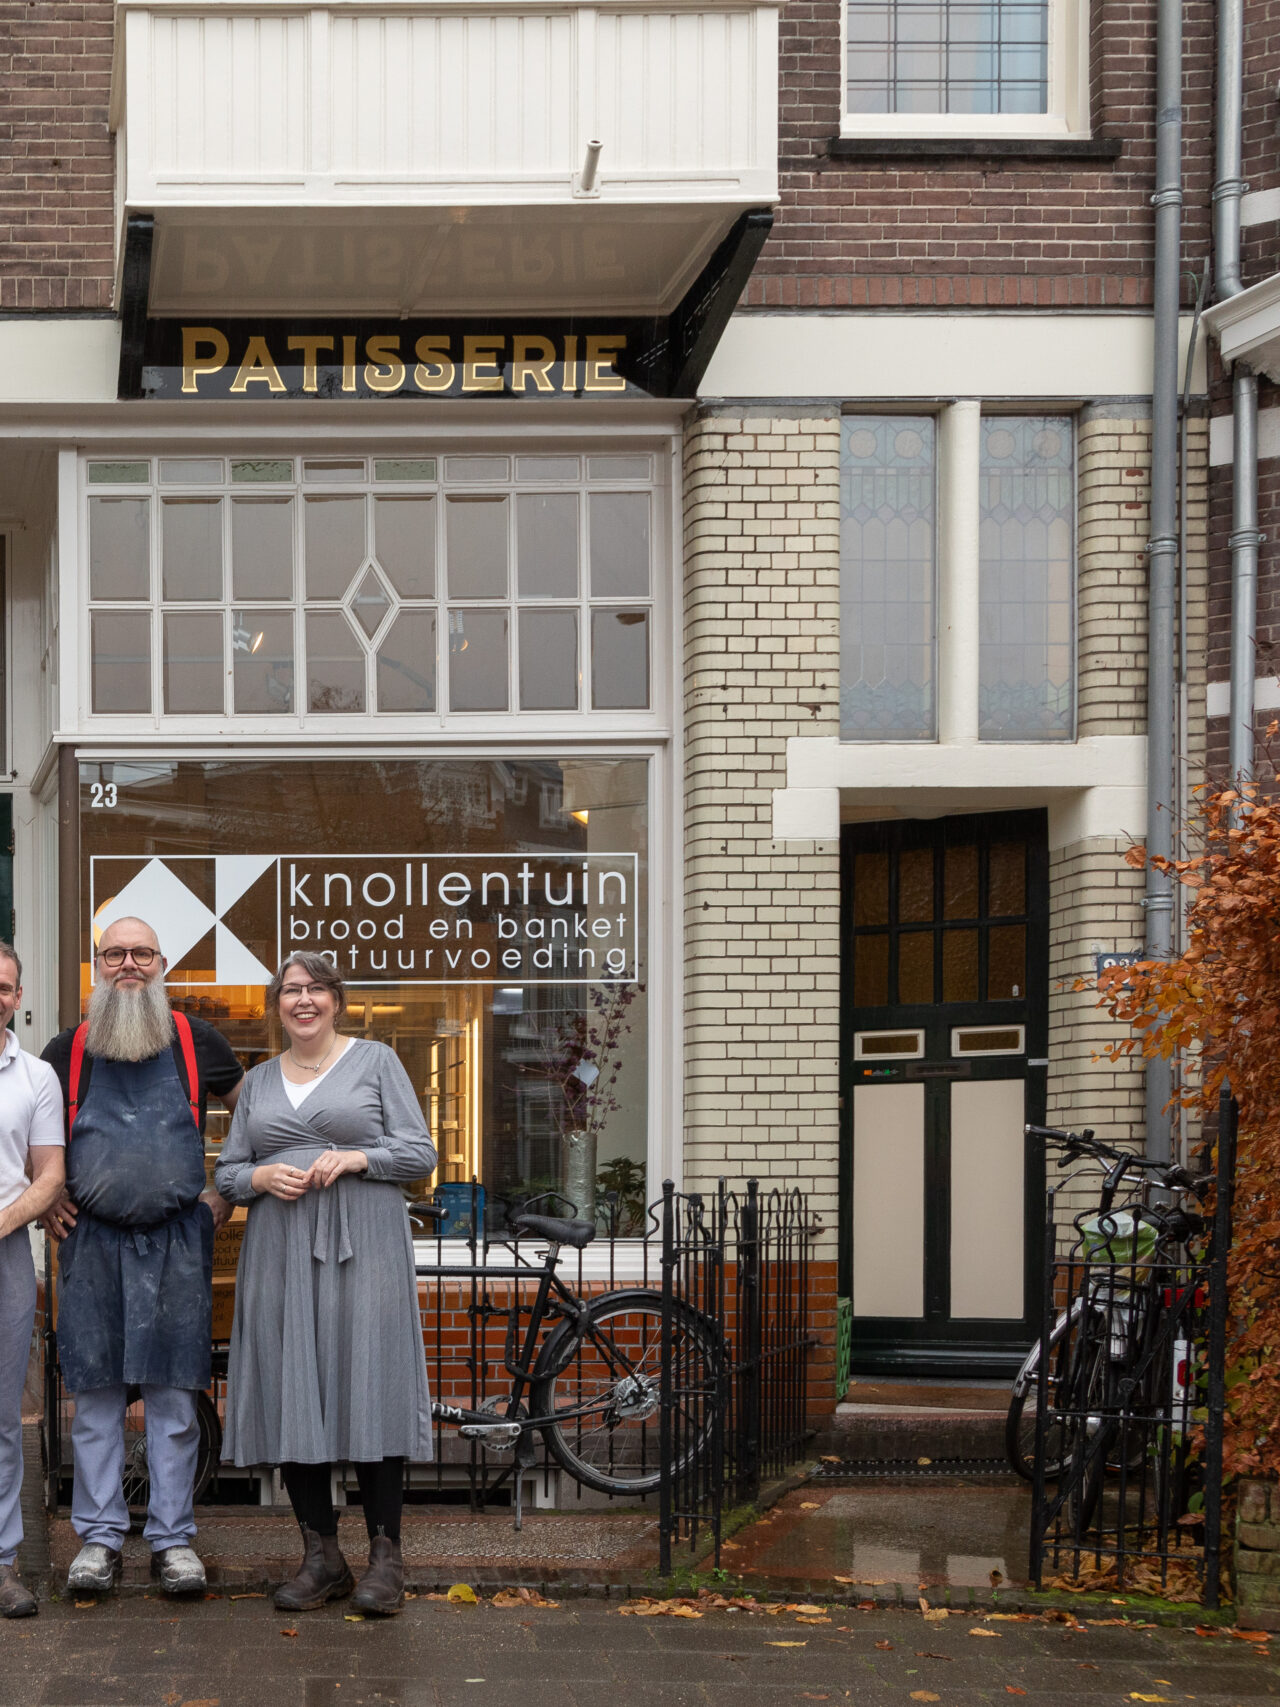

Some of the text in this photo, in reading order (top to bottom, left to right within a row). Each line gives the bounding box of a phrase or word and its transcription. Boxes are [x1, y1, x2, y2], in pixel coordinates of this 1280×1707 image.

[180, 327, 627, 394] PATISSERIE
[90, 782, 118, 808] 23
[290, 862, 627, 907] knollentuin
[290, 912, 627, 940] brood en banket
[290, 943, 627, 974] atuurvoeding
